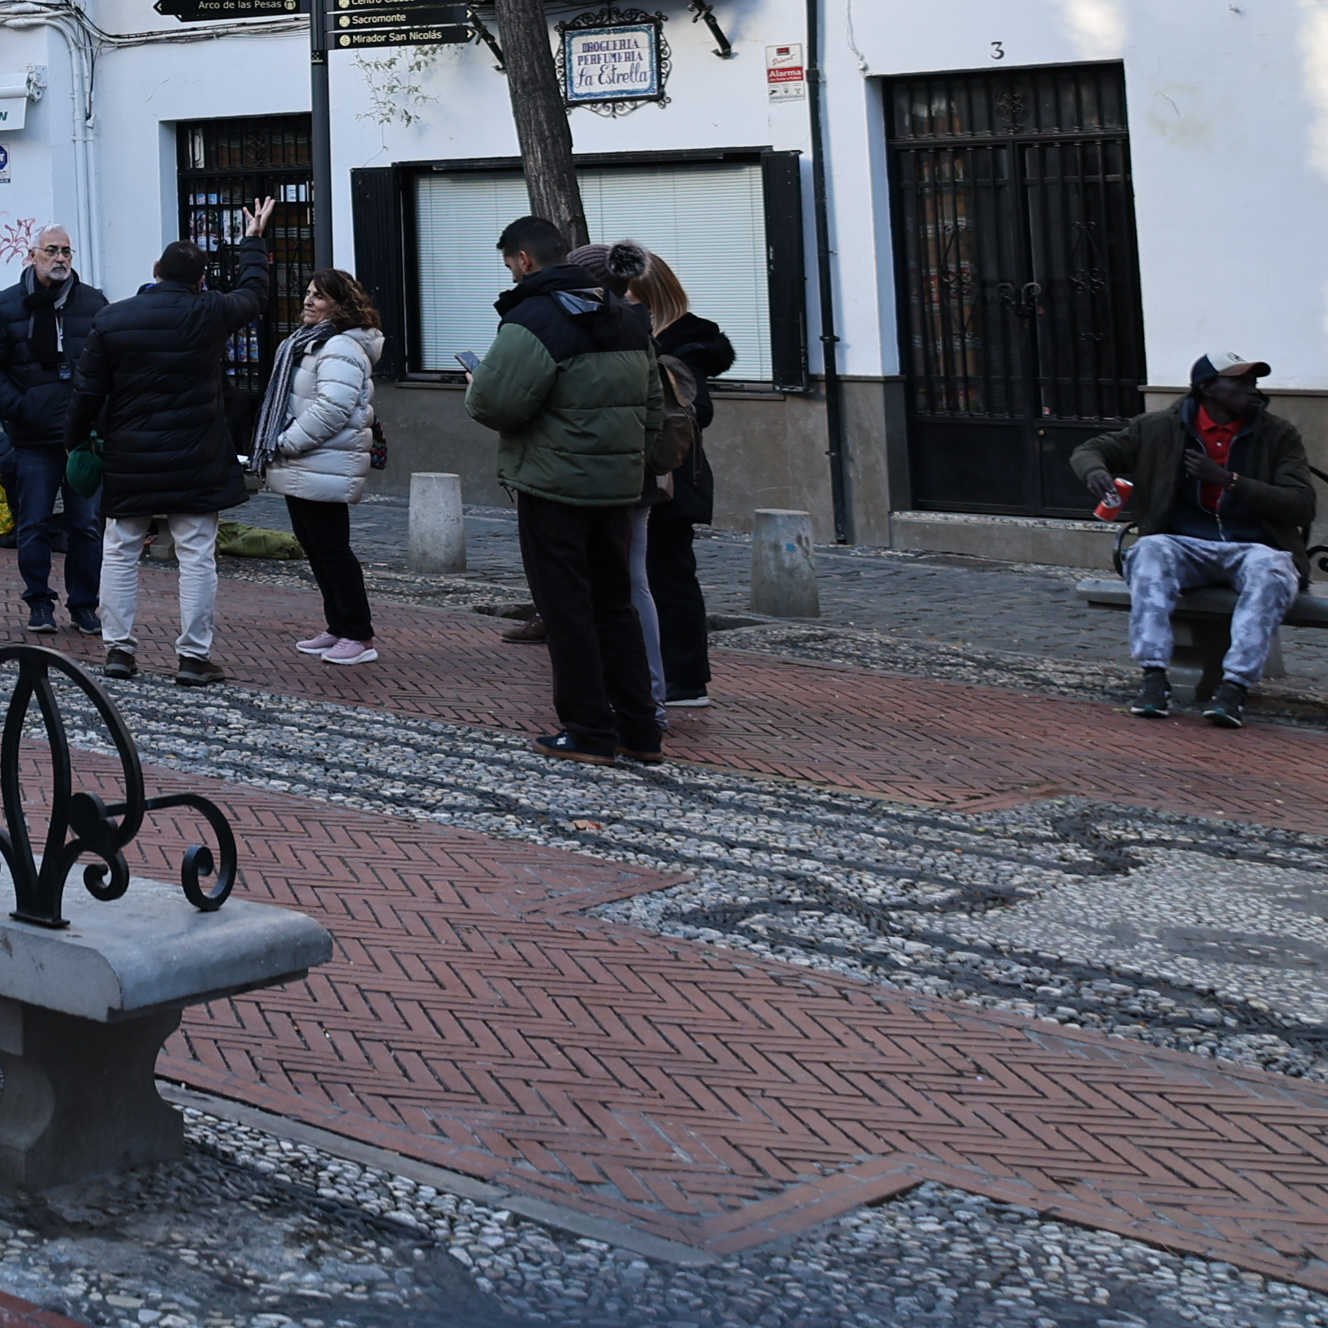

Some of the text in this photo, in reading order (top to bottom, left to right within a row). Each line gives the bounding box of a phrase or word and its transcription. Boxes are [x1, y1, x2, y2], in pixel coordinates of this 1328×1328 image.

[198, 0, 282, 9] Arco de las Pesas
[351, 13, 407, 24] Sacromonte
[352, 30, 442, 43] Mirador San Nicolás
[581, 38, 641, 53] DROGUERIA
[991, 41, 1005, 60] 3
[577, 50, 643, 66] PERFUMERIA
[598, 62, 648, 85] Estrella
[768, 69, 803, 77] Alarma
